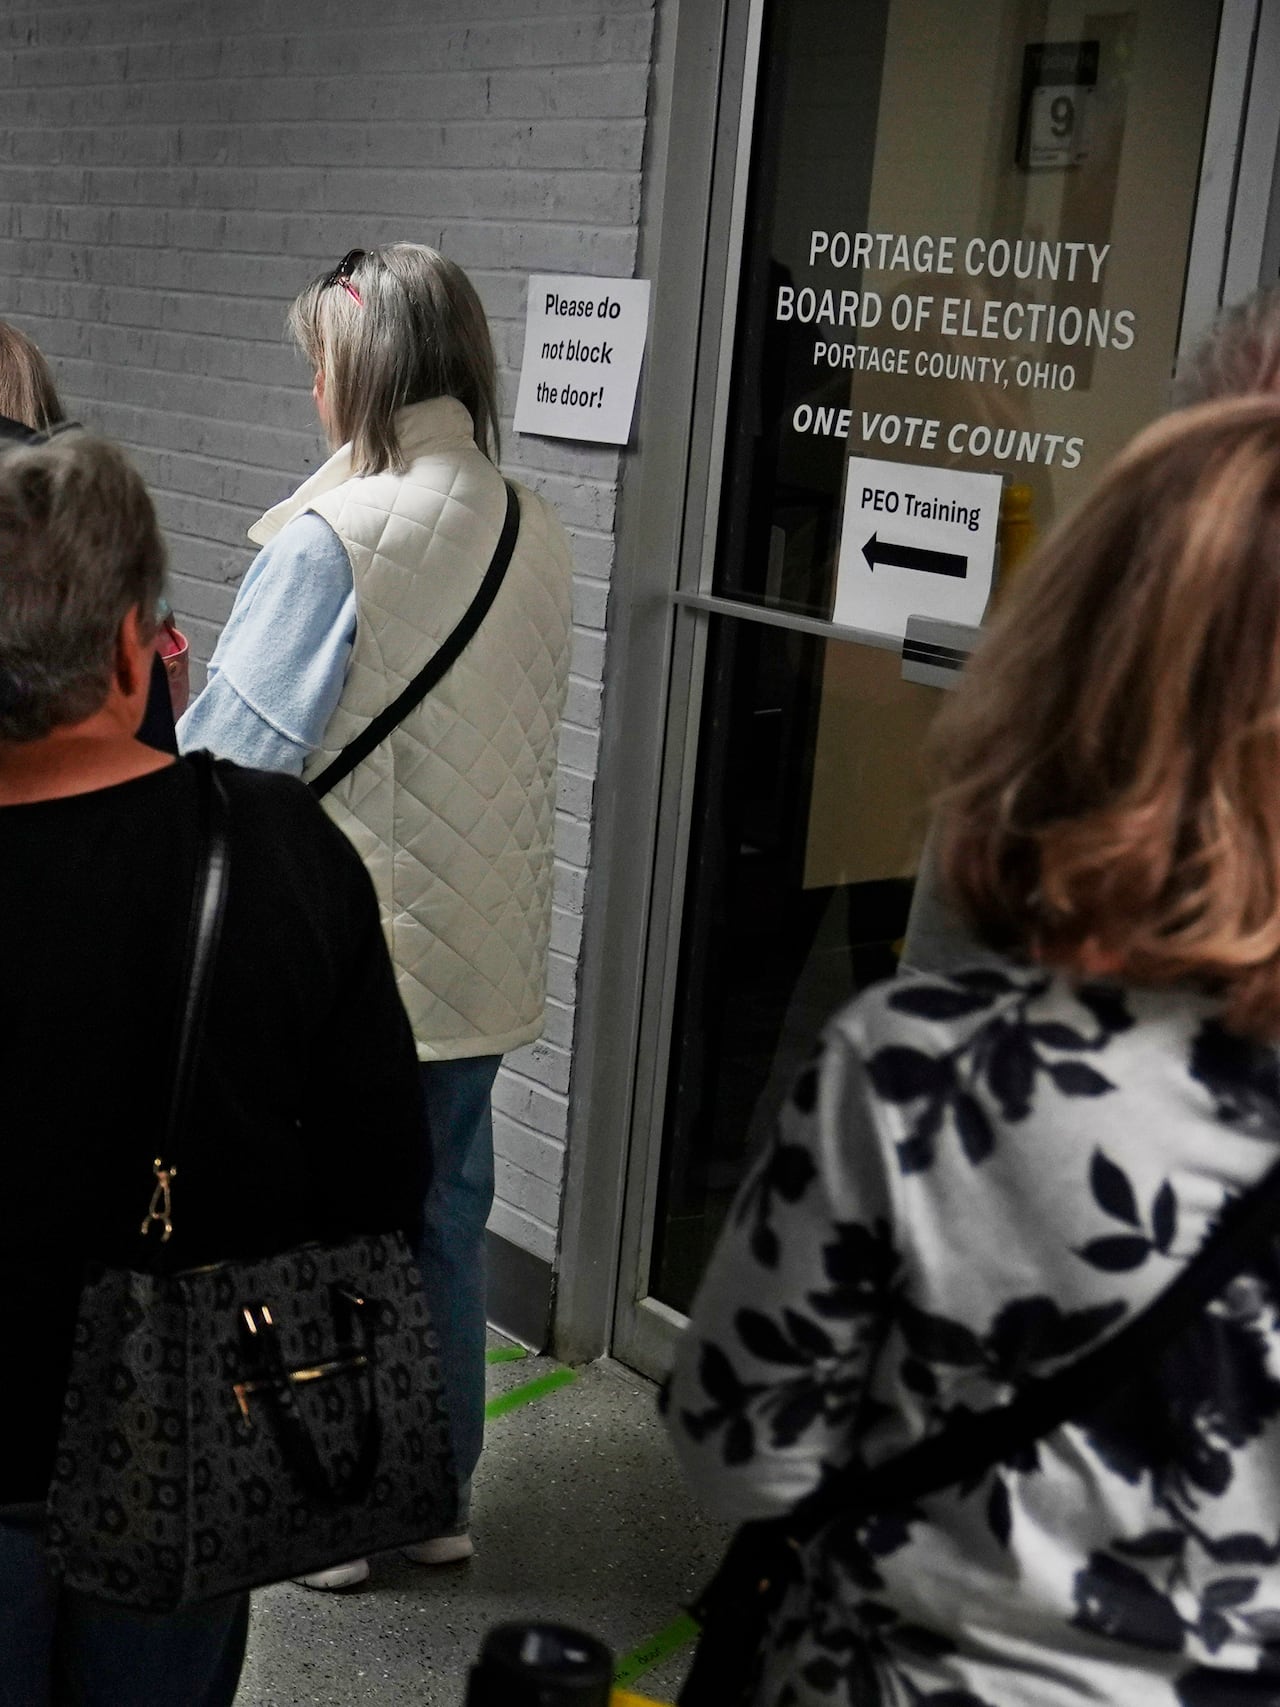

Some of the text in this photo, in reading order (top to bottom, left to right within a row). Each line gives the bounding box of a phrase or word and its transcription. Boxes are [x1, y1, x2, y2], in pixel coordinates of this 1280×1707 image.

[1050, 96, 1075, 138] 9
[809, 231, 1111, 283] PORTAGE COUNTY
[545, 294, 621, 319] Please do
[776, 286, 1135, 350] BOARD OF ELECTIONS
[541, 339, 613, 364] not block
[813, 342, 1075, 391] PORTAGE COUNTY, OHIO
[537, 382, 604, 408] the door!
[792, 404, 1084, 468] ONE VOTE COUNTS
[861, 487, 981, 531] PEO Training
